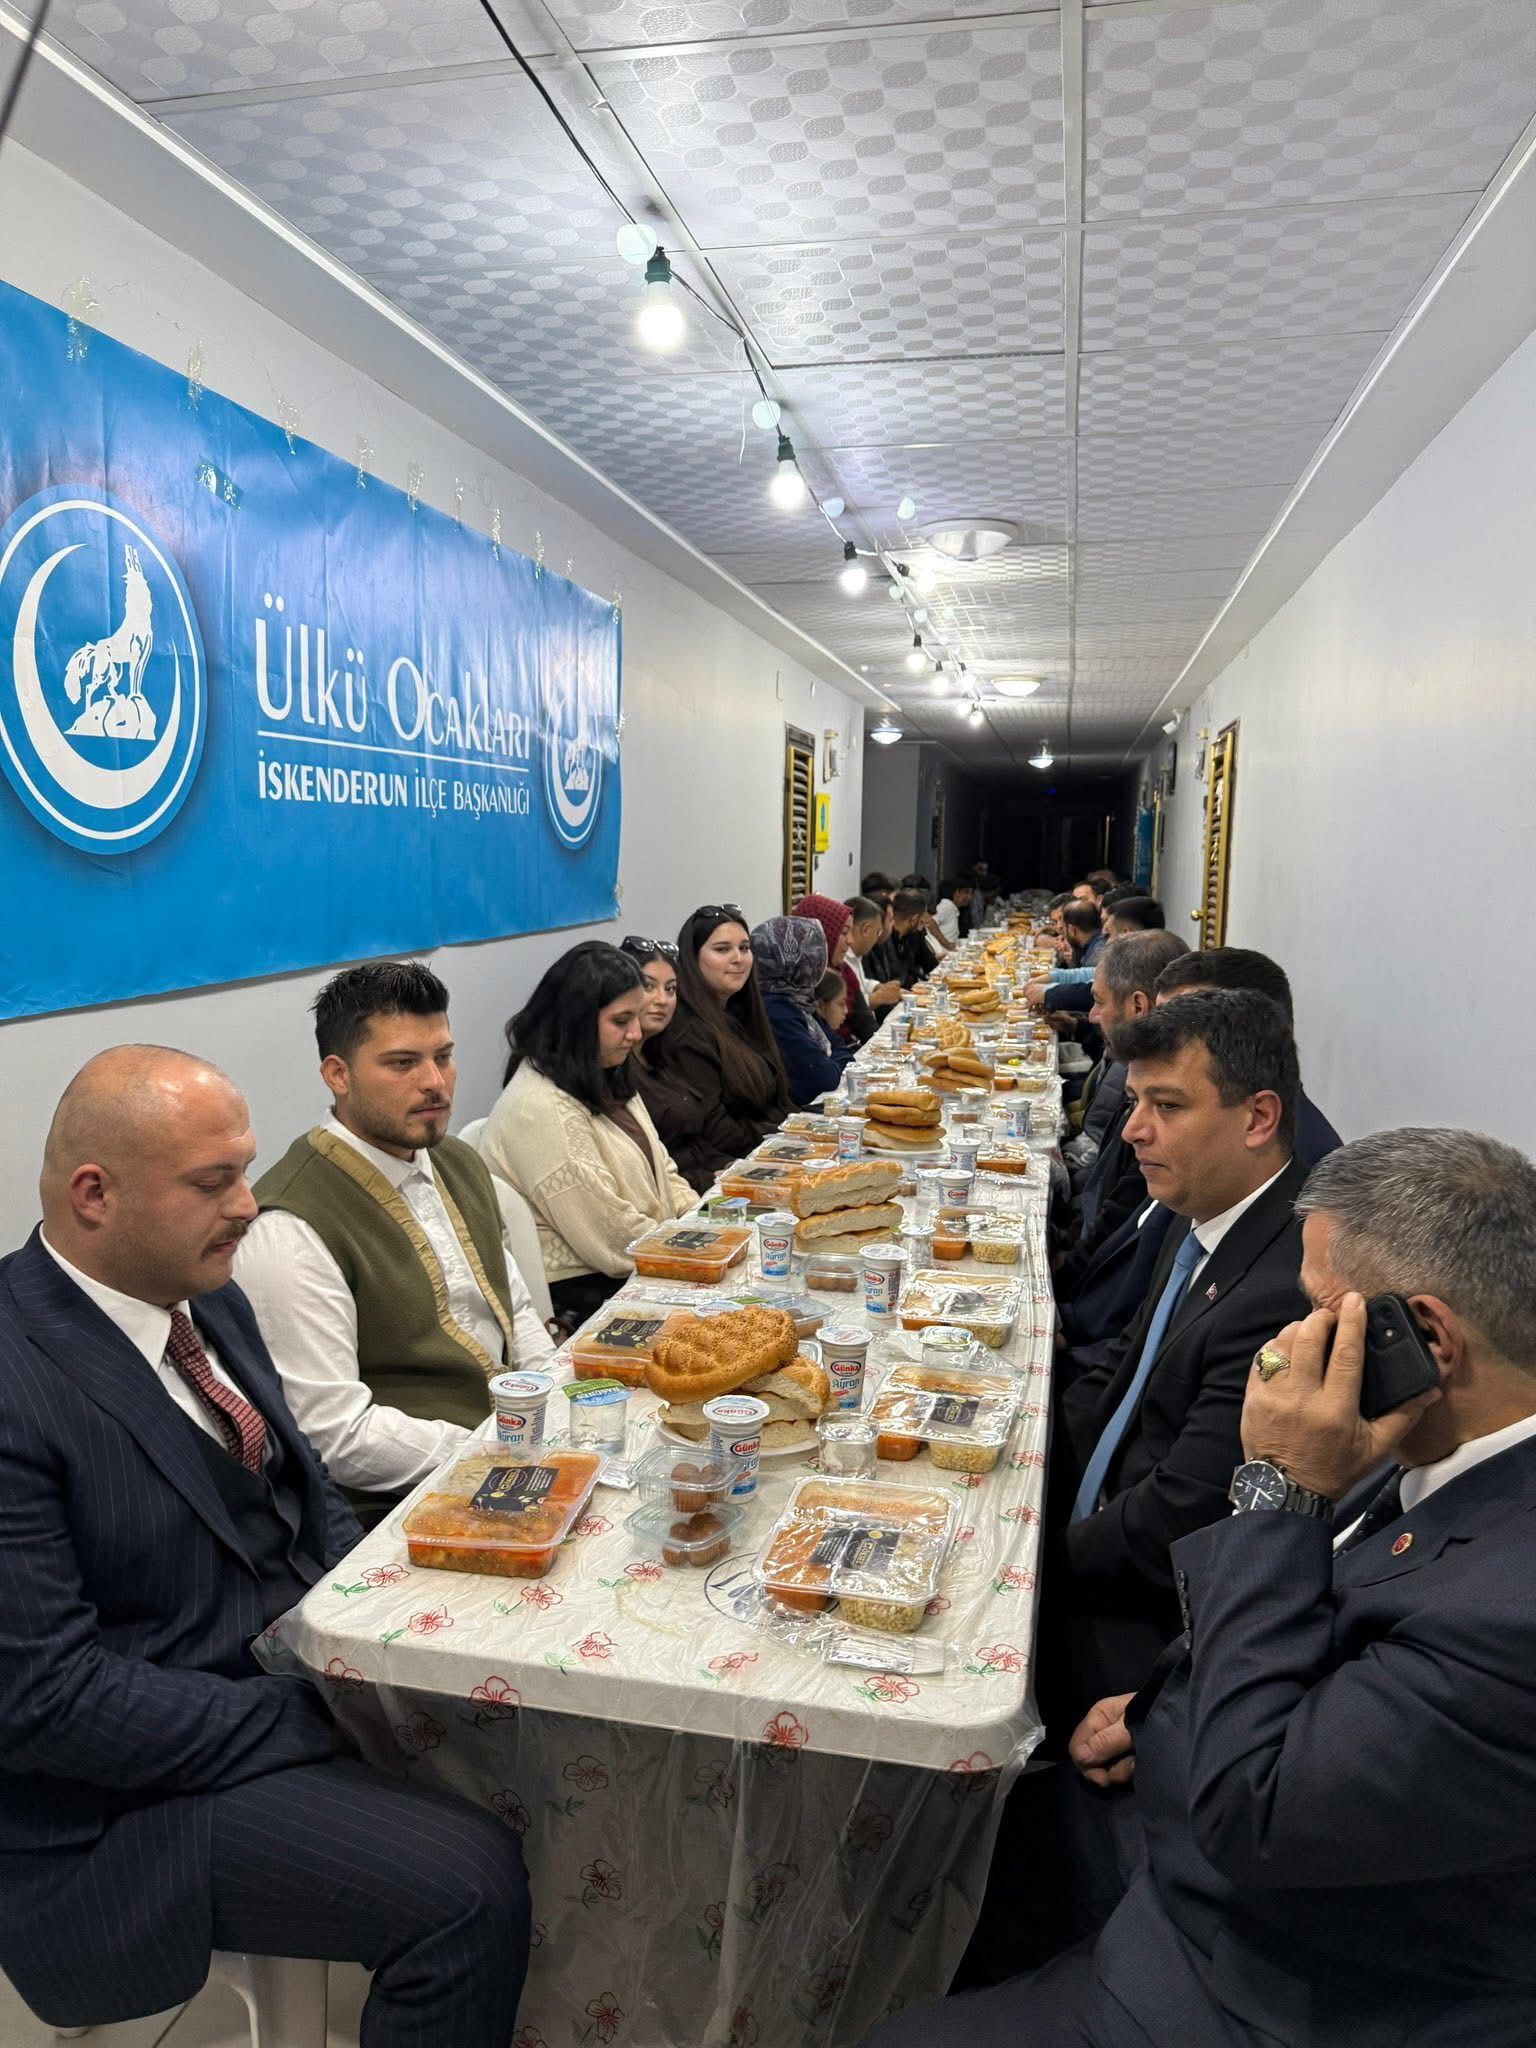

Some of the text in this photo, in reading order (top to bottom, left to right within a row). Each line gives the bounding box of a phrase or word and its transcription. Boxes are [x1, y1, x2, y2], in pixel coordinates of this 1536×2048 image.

[255, 592, 367, 733] Ülkü
[258, 749, 530, 820] İSKENDERUN İLÇE BAŞKANLIĞI
[832, 1378, 860, 1389] Ayran
[834, 1364, 860, 1373] Günka
